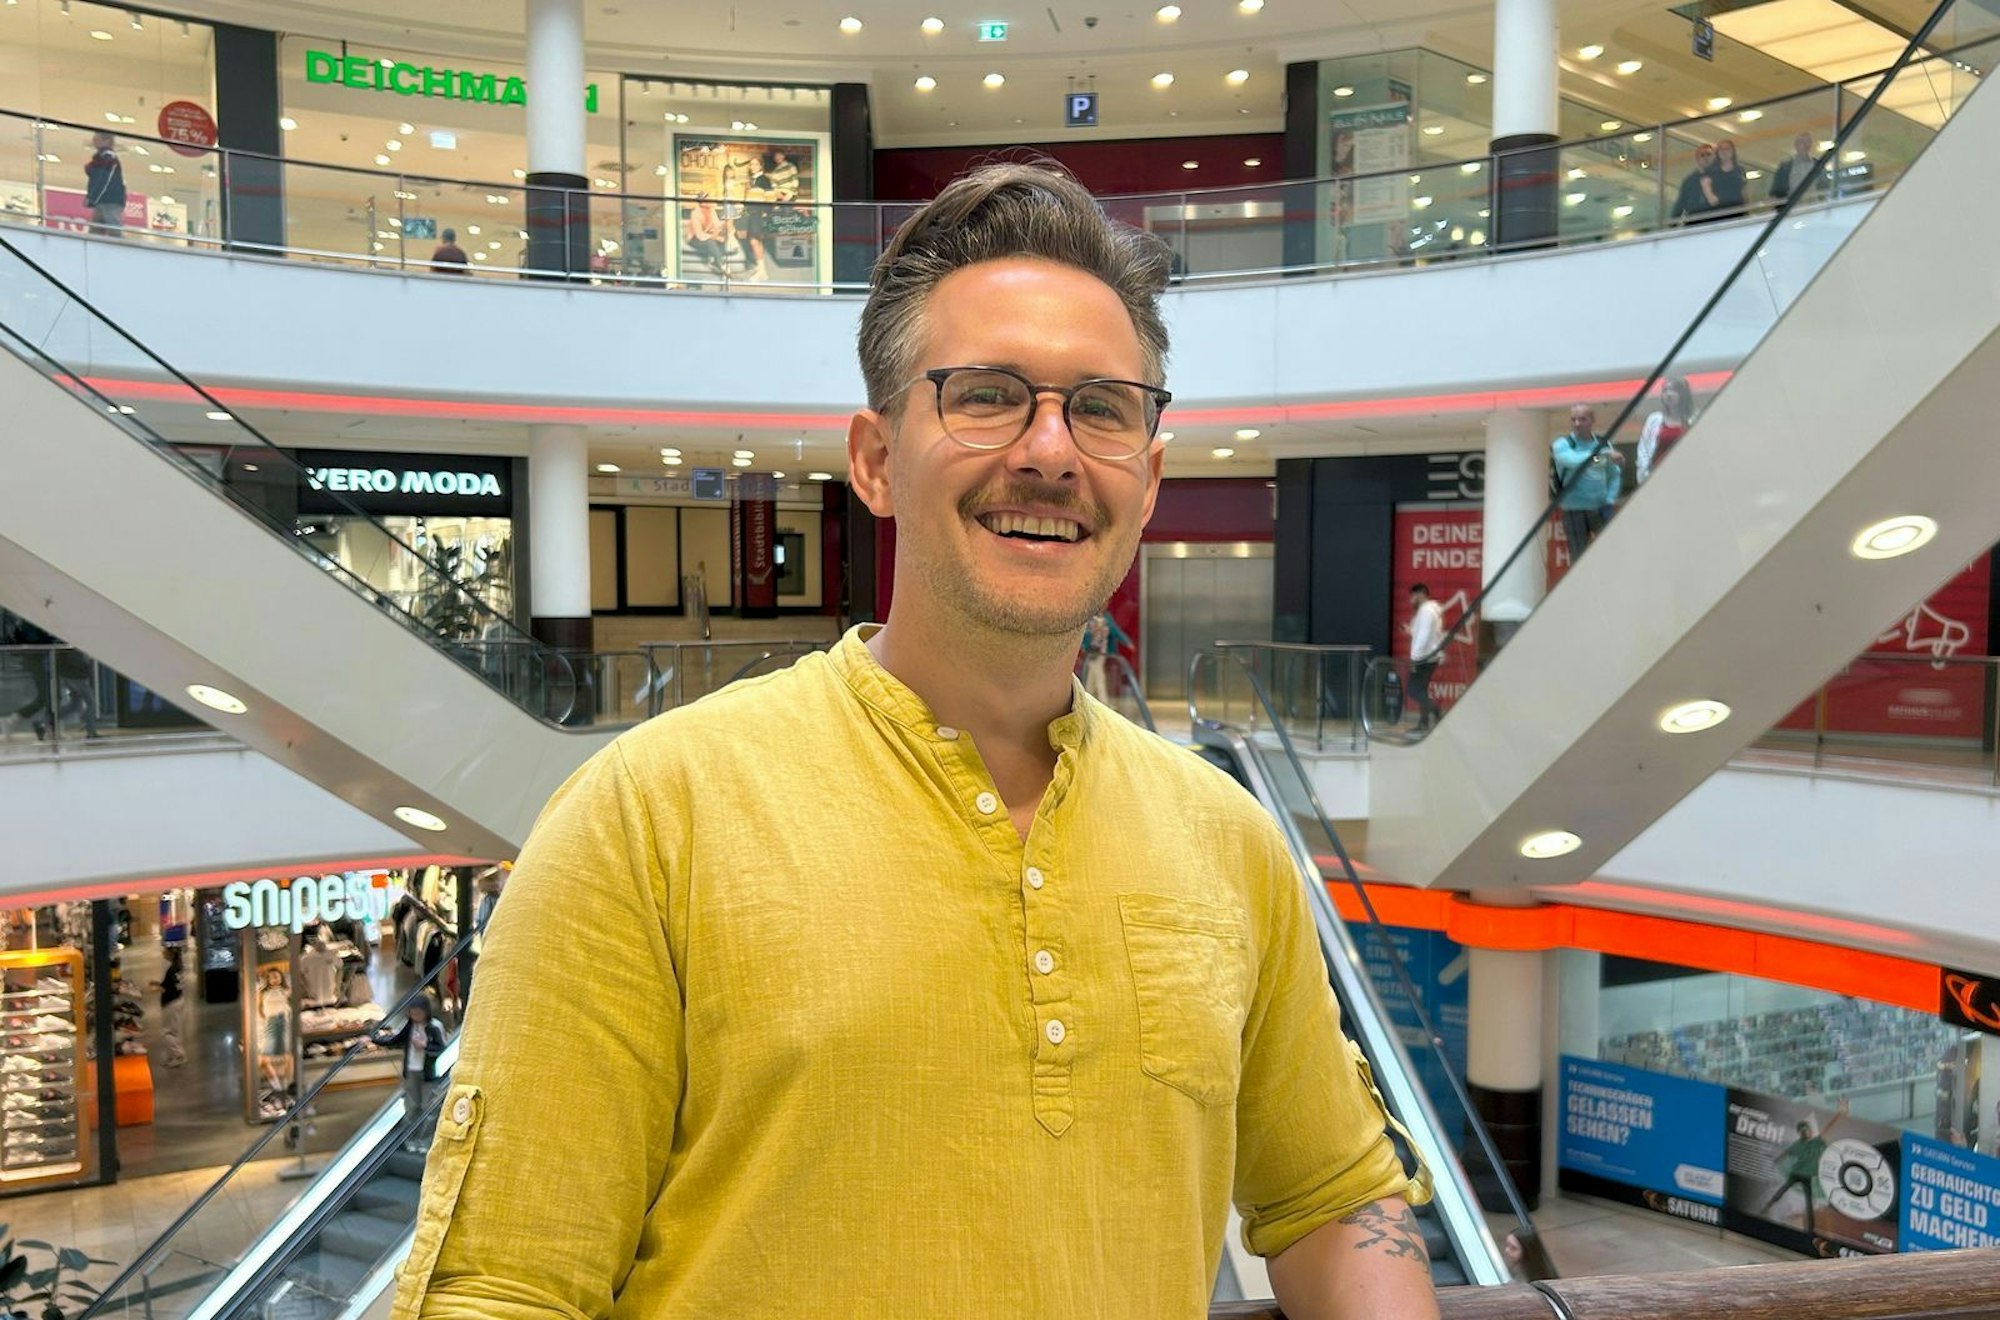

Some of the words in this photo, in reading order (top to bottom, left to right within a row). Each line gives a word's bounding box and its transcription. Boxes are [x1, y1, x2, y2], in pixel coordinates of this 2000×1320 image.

[306, 49, 598, 114] DEICHMA
[1072, 97, 1091, 118] P
[305, 467, 397, 493] VERO
[401, 471, 501, 497] MODA
[1412, 525, 1483, 545] DEINE
[1412, 550, 1481, 570] FINDE
[223, 873, 371, 934] snipes
[1567, 1094, 1654, 1131] GELASSEN
[1567, 1114, 1631, 1147] SEHEN?
[1735, 1115, 1786, 1144] Dreh!
[1668, 1197, 1719, 1223] SATURN
[1910, 1182, 1934, 1211] ZU
[1940, 1192, 1988, 1229] GELD
